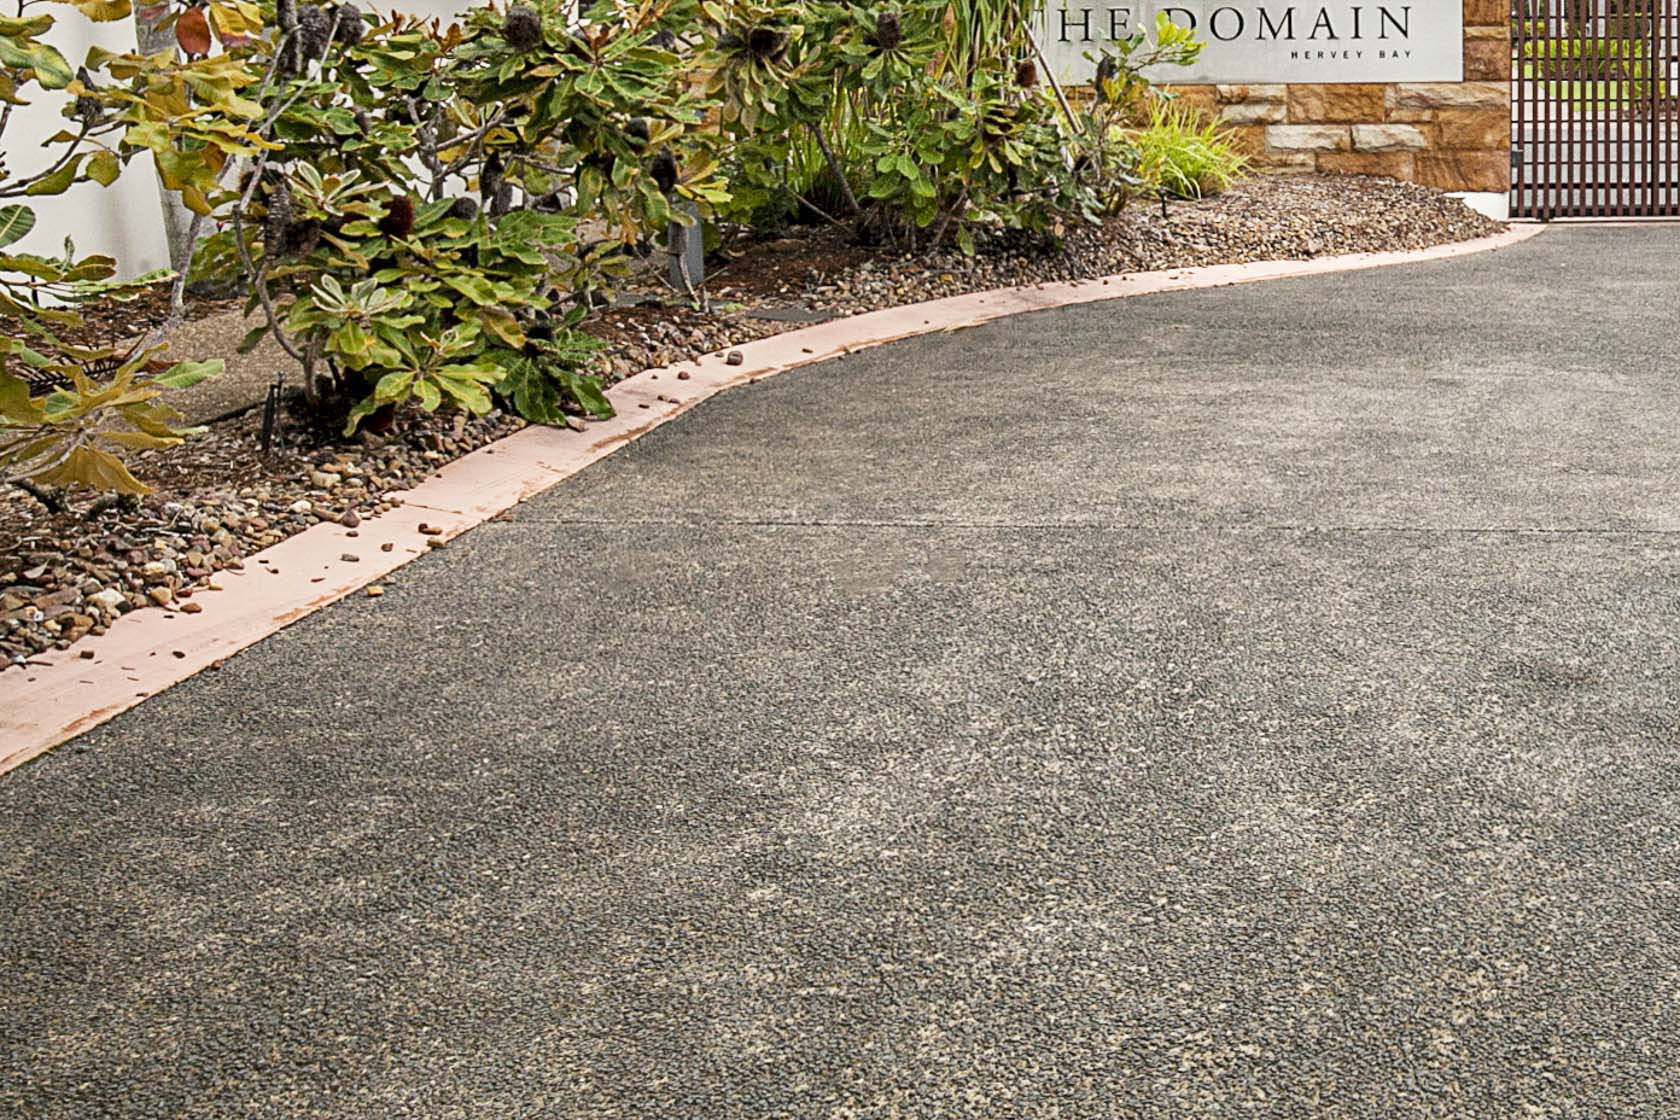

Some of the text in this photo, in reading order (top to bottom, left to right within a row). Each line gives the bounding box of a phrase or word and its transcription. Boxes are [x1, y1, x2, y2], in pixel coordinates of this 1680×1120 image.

[1032, 7, 1135, 42] HE
[1291, 50, 1410, 60] HERVEY BAY
